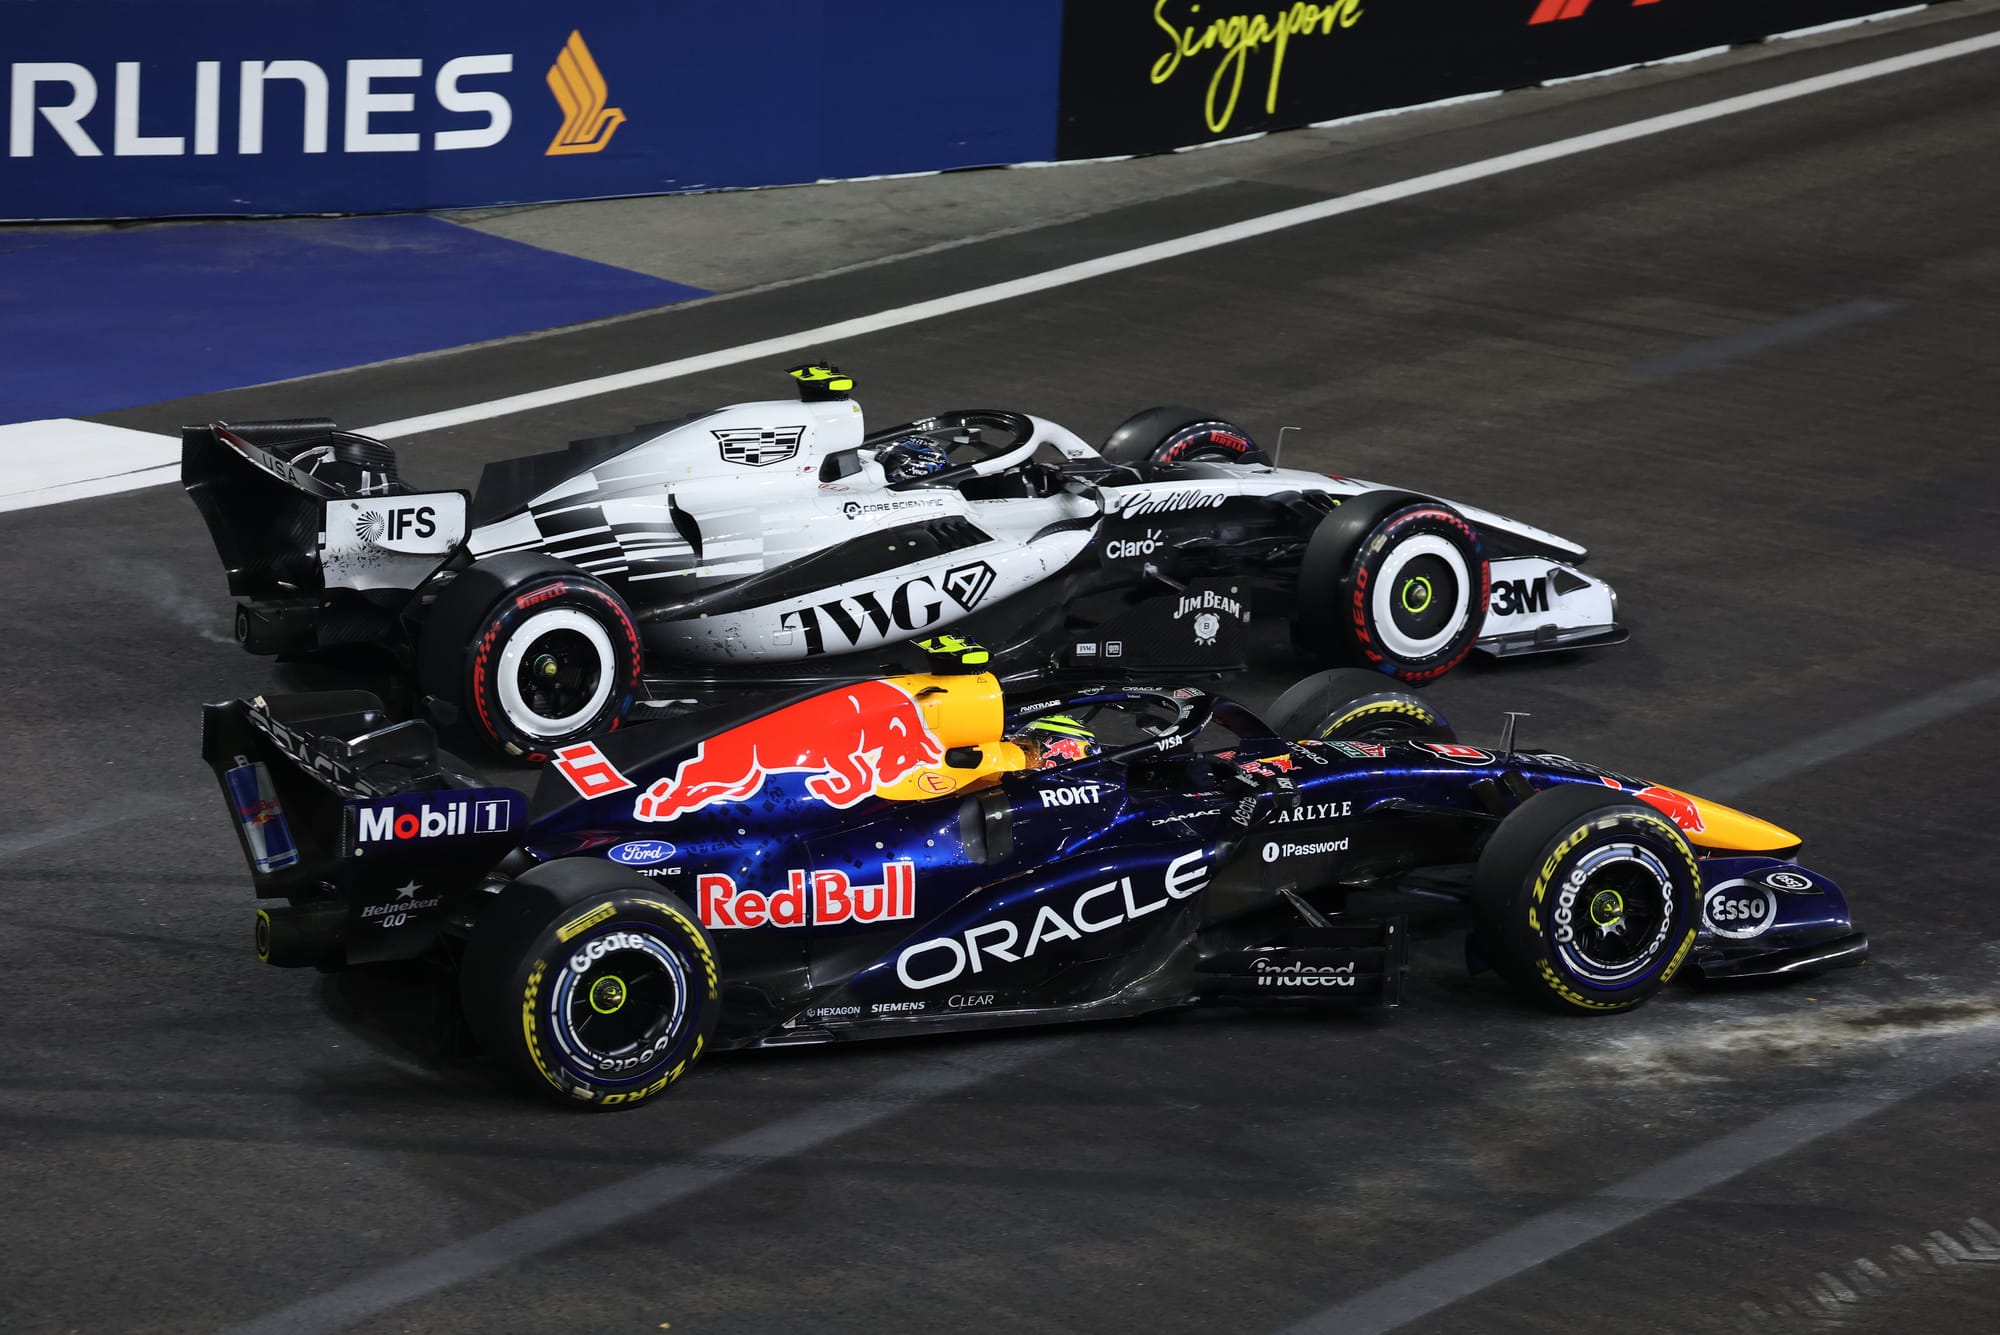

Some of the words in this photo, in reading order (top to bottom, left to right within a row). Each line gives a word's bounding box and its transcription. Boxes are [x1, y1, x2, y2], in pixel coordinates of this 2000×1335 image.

[1151, 0, 1364, 133] Singapore
[1211, 430, 1247, 453] PIRELLI
[262, 453, 299, 483] USA
[863, 503, 891, 513] CORE
[893, 499, 944, 510] SCIENTIFIC
[1119, 489, 1227, 519] Cadillac
[387, 506, 436, 541] IFS
[1106, 535, 1160, 558] Claro
[1173, 596, 1201, 619] JIM
[1203, 590, 1241, 618] BEAM
[1353, 566, 1369, 643] ZERO
[1490, 577, 1549, 617] 3M
[780, 575, 944, 656] TWG
[1156, 734, 1183, 752] VISA
[928, 777, 948, 791] E
[359, 802, 467, 841] Mobil
[1152, 809, 1221, 826] DAMAC
[1269, 801, 1352, 824] ARLYLE
[622, 843, 666, 860] Ford
[1282, 838, 1349, 857] 1Password
[1532, 824, 1590, 904] ZERO
[361, 897, 440, 918] Heineken
[697, 869, 806, 929] Red
[810, 861, 915, 926] Bull
[896, 849, 1210, 989] ORACLE
[1529, 906, 1541, 931] P
[1256, 961, 1355, 986] indeed
[817, 1006, 861, 1017] HEXAGON
[871, 1001, 926, 1013] SIEMENS
[948, 994, 994, 1008] CLEAR
[600, 1059, 687, 1105] ZERO
